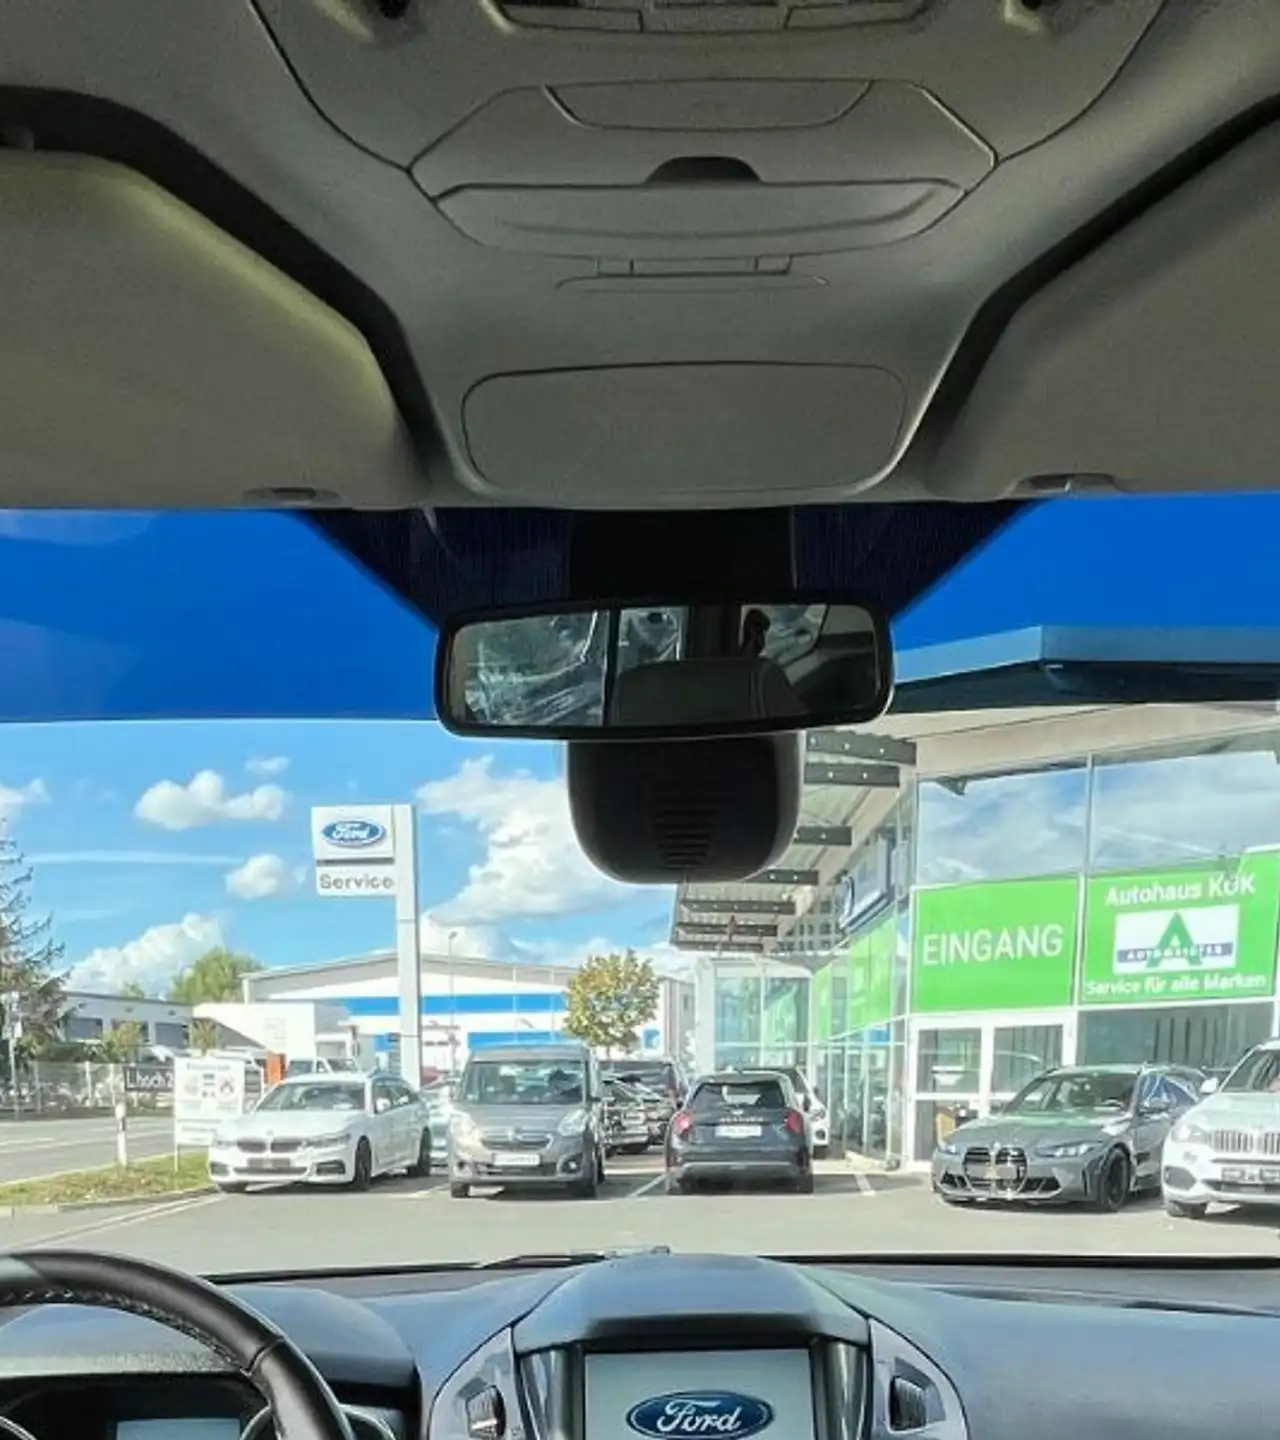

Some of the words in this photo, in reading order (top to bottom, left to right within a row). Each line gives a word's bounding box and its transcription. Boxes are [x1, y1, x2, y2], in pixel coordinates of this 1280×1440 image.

[320, 873, 394, 889] Service
[1104, 881, 1202, 906] Autohaus
[922, 924, 1064, 966] EINGANG
[1086, 979, 1139, 996] Service
[1144, 976, 1168, 993] für
[1171, 976, 1200, 992] alle
[1205, 973, 1267, 990] Marken
[657, 1399, 742, 1432] Ford
